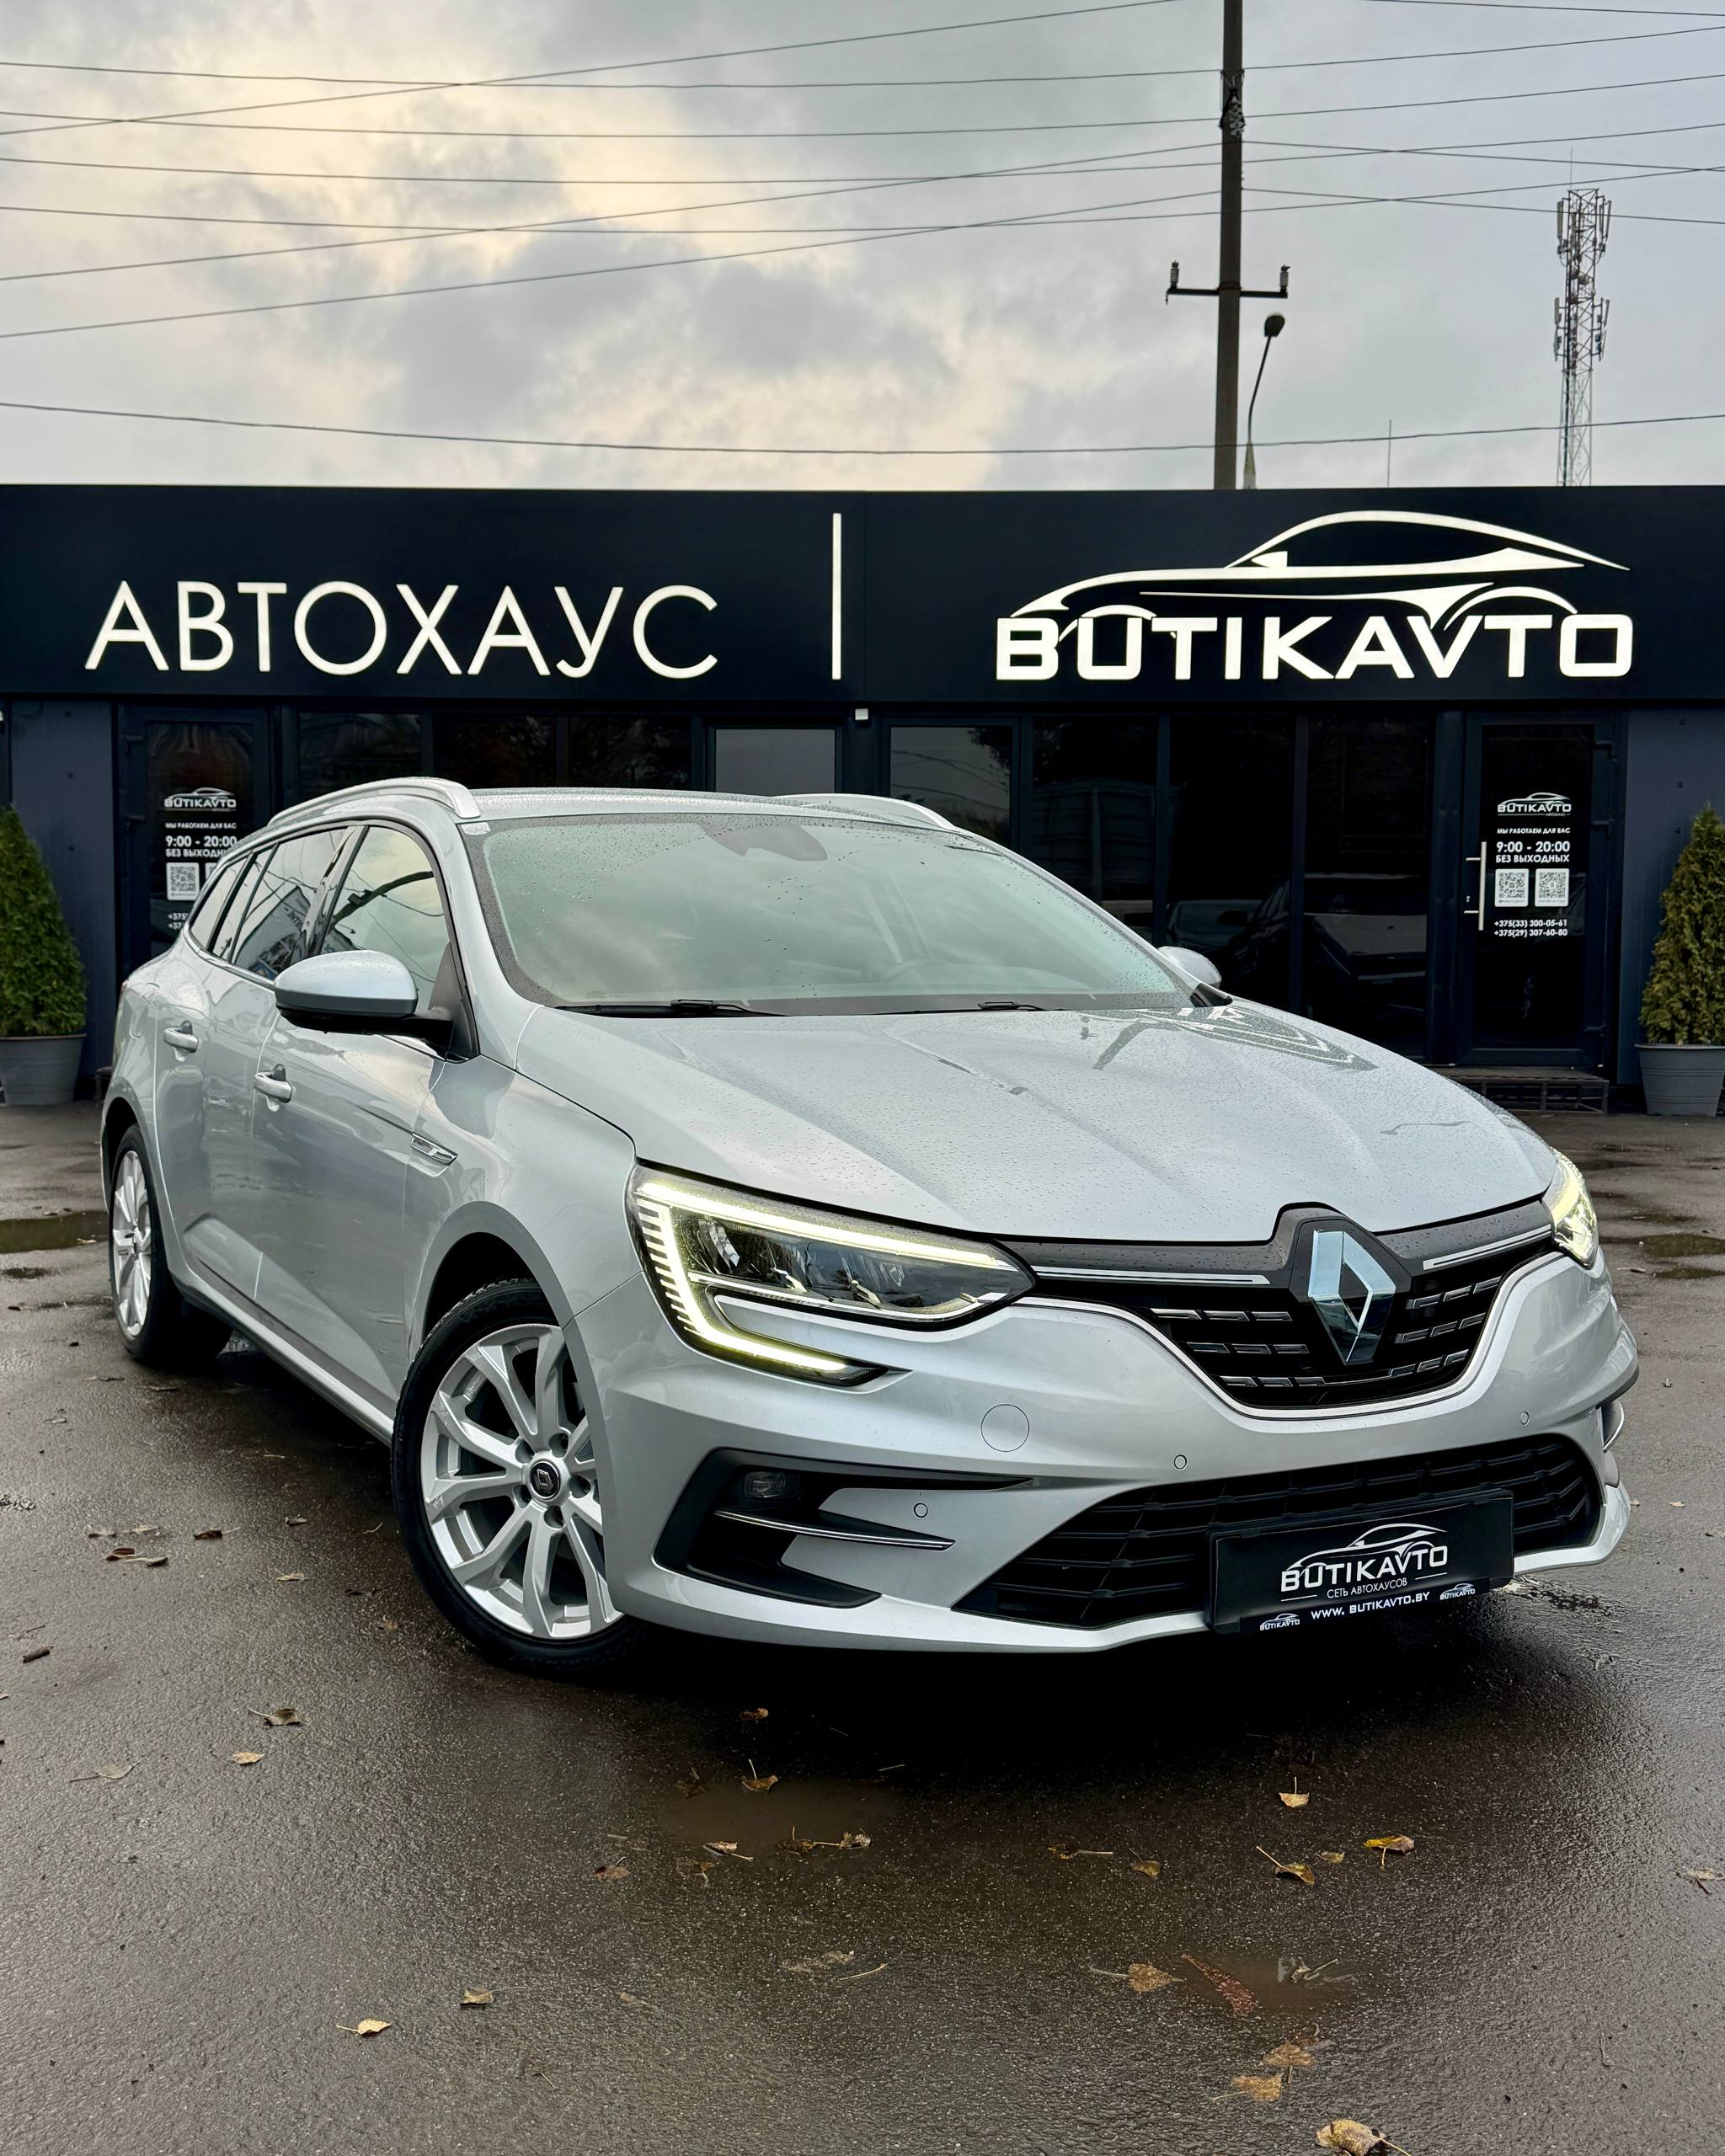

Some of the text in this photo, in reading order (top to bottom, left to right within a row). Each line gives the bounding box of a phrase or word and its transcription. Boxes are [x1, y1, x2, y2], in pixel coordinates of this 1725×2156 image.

[84, 580, 719, 680] АВТОХАУС
[996, 613, 1634, 681] BUTIKAVTO
[164, 799, 237, 808] BUTIKAVTO
[1497, 803, 1571, 812] BUTIKAVTO
[165, 835, 191, 847] 9:00
[204, 835, 237, 847] 20:00
[1497, 841, 1523, 852] 9:00
[1535, 841, 1570, 852] 20:00
[166, 848, 227, 857] БЕЗ ВЫХОДН
[1514, 855, 1569, 863] ВЫХОДНЫХ
[1281, 1545, 1448, 1592] BUTIKAVTO
[1327, 1577, 1407, 1599] СЕТЬ АВТОХАУСОВ
[1311, 1592, 1430, 1620] WWW. BUTIKAVTO.BY
[1259, 1619, 1300, 1630] BUTIKAVTO
